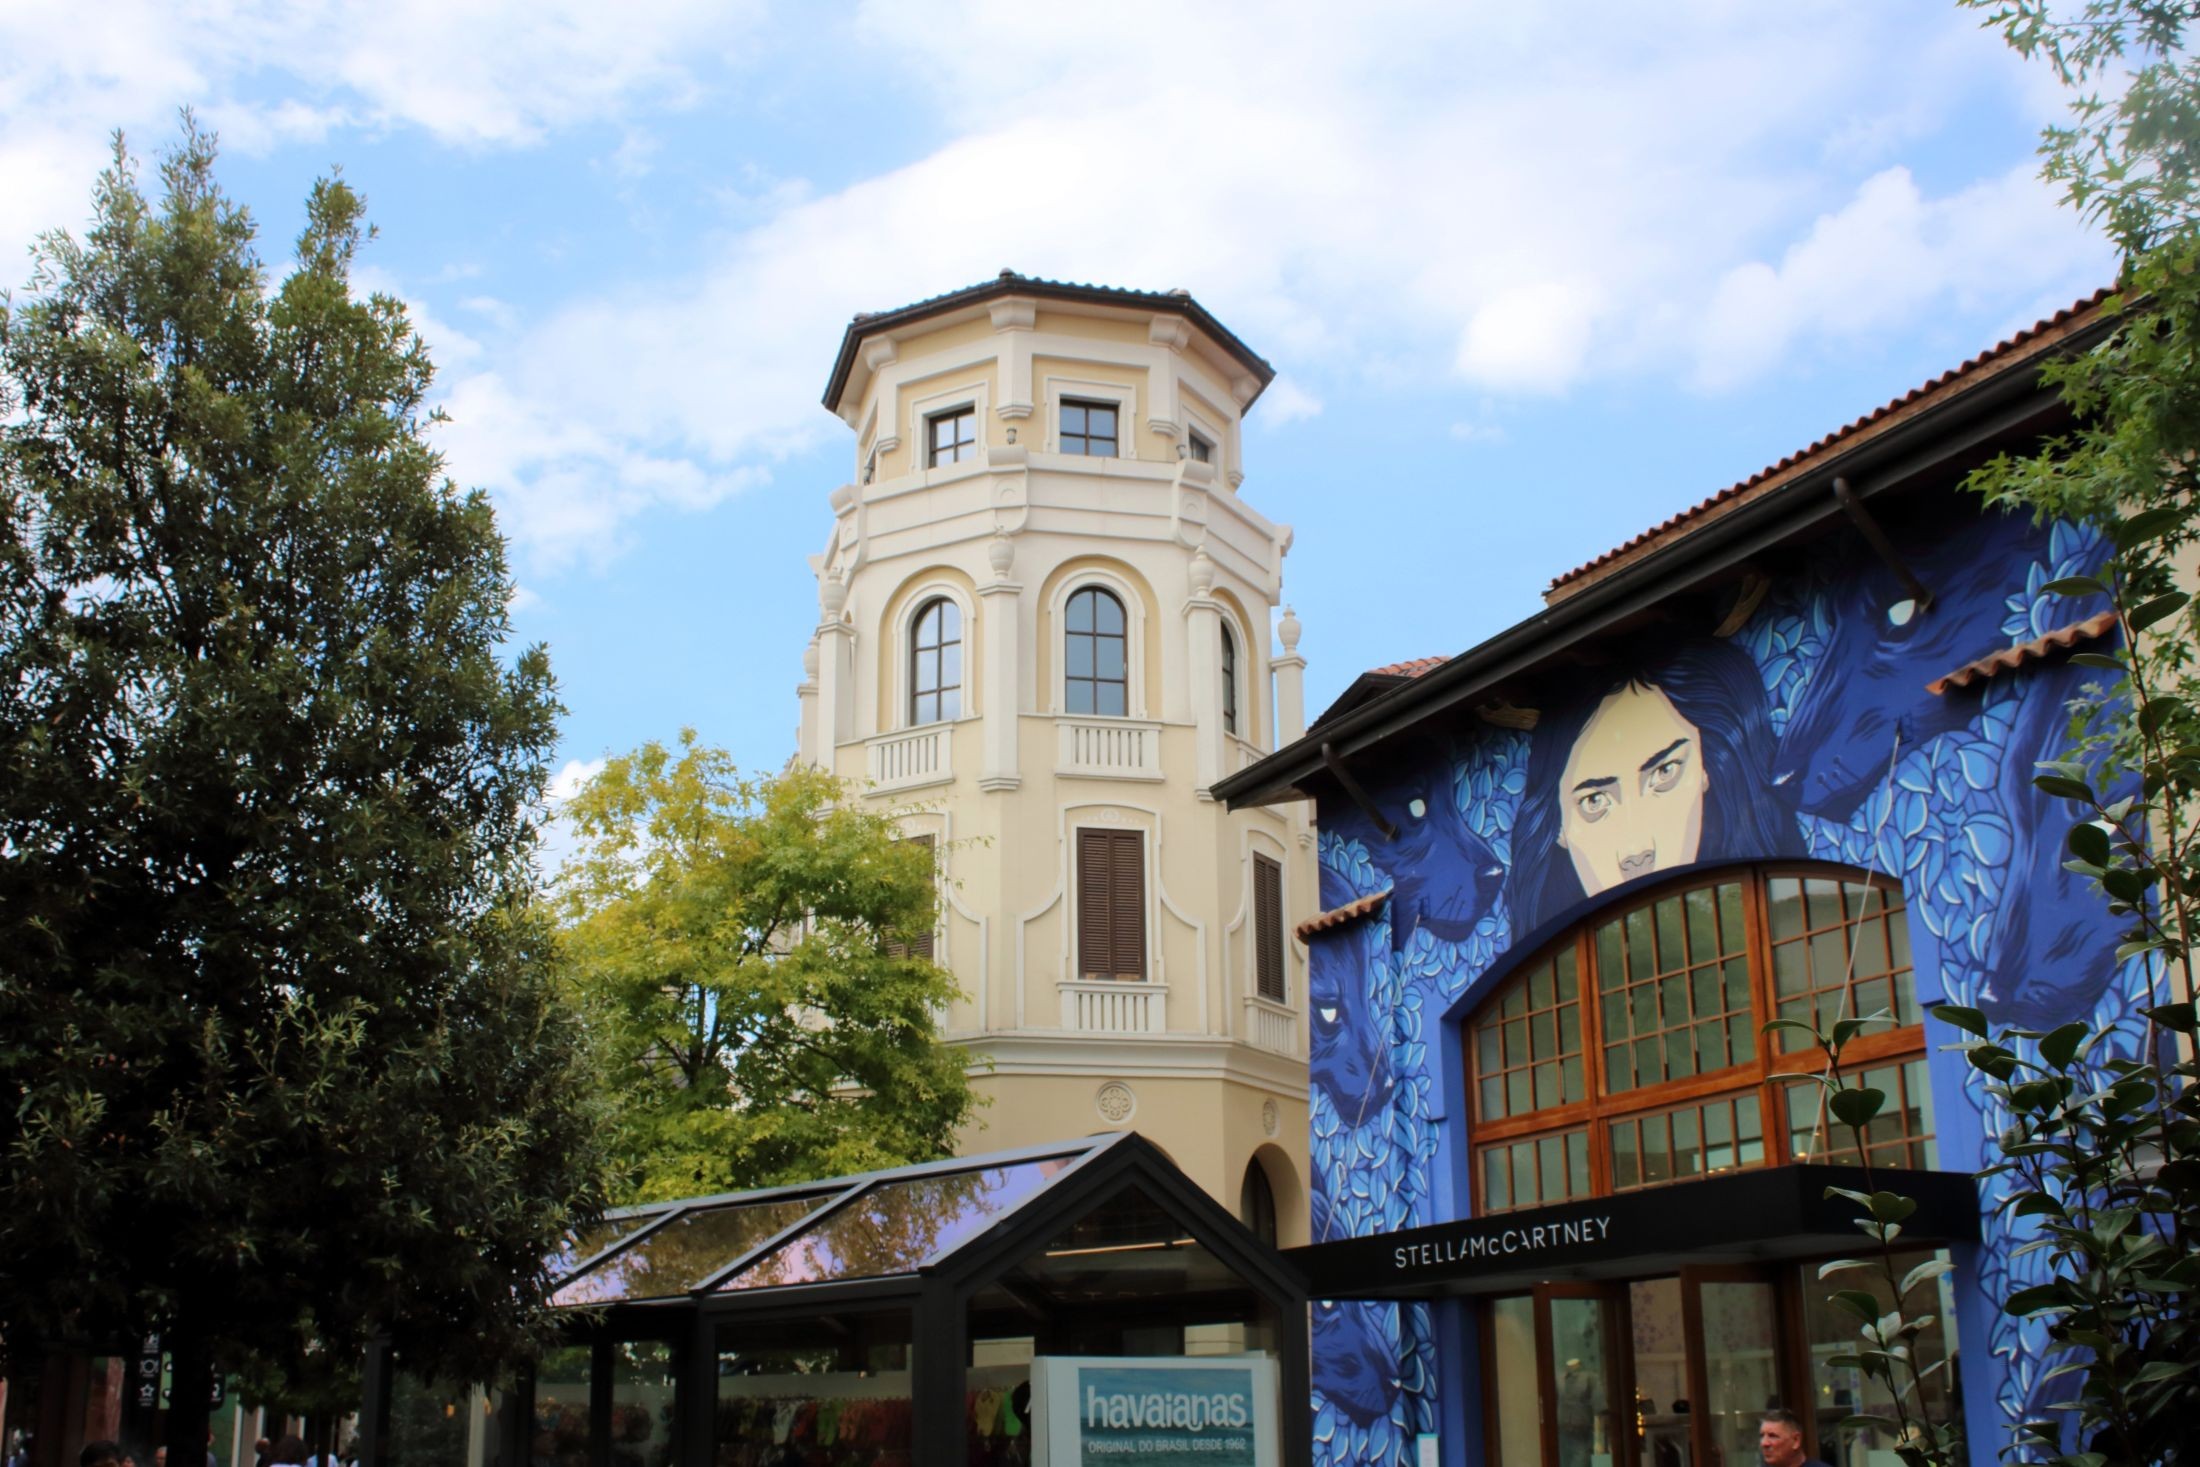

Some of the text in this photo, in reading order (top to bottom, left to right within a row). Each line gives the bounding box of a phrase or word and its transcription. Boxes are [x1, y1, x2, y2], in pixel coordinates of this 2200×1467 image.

[1086, 1385, 1248, 1432] havaianas
[1088, 1437, 1247, 1454] ORIGINAL DO BRASIL DESDE 1962
